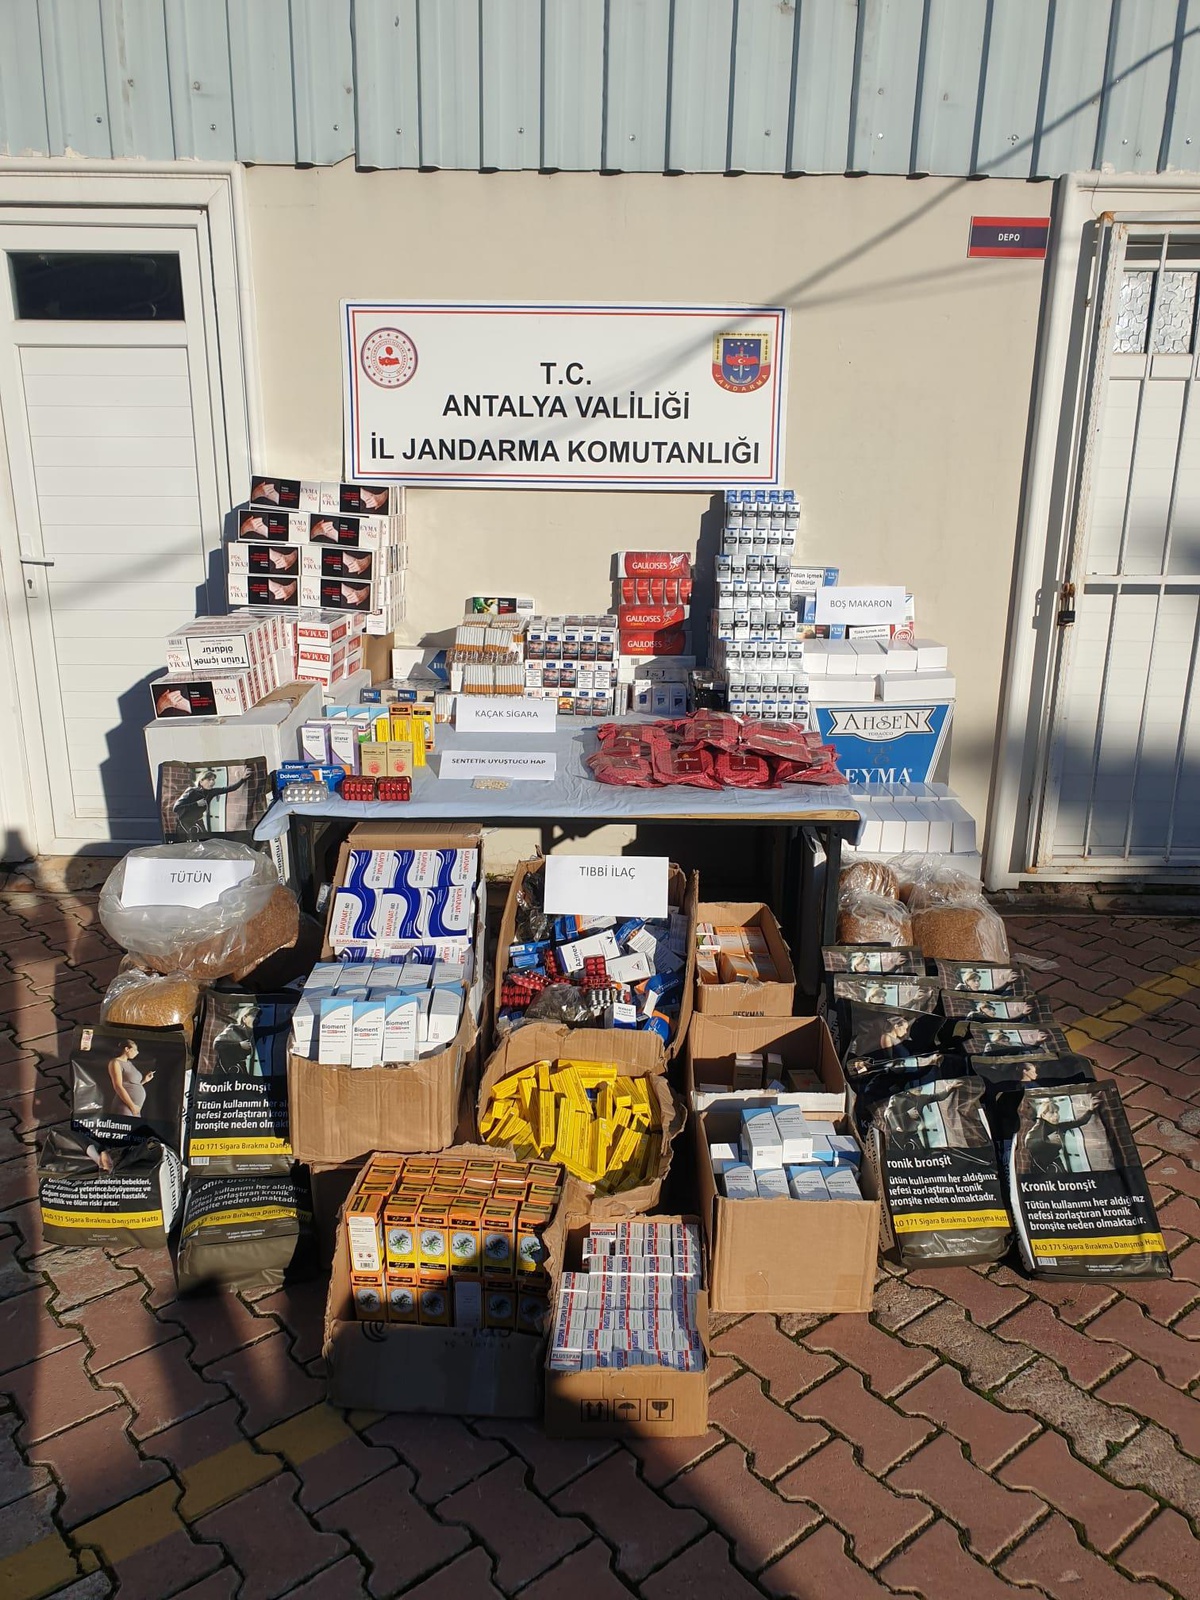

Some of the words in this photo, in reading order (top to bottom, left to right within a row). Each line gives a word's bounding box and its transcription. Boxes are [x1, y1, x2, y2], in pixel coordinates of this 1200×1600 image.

[997, 233, 1020, 242] DEPO
[540, 362, 592, 386] T.C.
[442, 394, 567, 418] ANTALYA
[575, 391, 690, 420] VALİLİĞİ
[371, 432, 394, 460] İL
[402, 437, 560, 463] JANDARMA
[568, 436, 760, 464] KOMUTANLIĞI
[830, 600, 847, 609] BOŞ
[849, 600, 892, 608] MAKARON
[202, 645, 233, 654] öldürür
[194, 657, 217, 666] içmek
[222, 656, 246, 665] Tütün
[475, 710, 504, 718] KAÇAK
[506, 709, 539, 718] SİGARA
[843, 712, 920, 730] AHSEN
[844, 768, 912, 784] EYMA
[170, 871, 212, 883] TÜTÜN
[580, 865, 608, 877] TIBBİ
[611, 865, 636, 879] İLAÇ
[199, 1081, 232, 1093] Kronik
[235, 1081, 271, 1093] bronşit
[197, 1101, 221, 1109] Tütün
[223, 1099, 261, 1108] kullanımı
[196, 1111, 221, 1119] nefesi
[223, 1110, 267, 1119] zorlaştıran
[97, 1119, 132, 1131] kullanımı
[195, 1121, 229, 1131] bronşite
[231, 1120, 257, 1128] neden
[192, 1143, 204, 1151] ALO
[219, 1143, 240, 1151] Sigara
[887, 1158, 913, 1169] ronik
[914, 1155, 952, 1167] bronşit
[889, 1176, 908, 1185] ütün
[909, 1174, 947, 1185] kullanımı
[948, 1174, 961, 1183] her
[962, 1172, 997, 1183] aldığınız
[913, 1184, 955, 1197] zorlaştıran
[955, 1183, 983, 1193] kronik
[1021, 1181, 1057, 1193] Kronik
[1058, 1179, 1097, 1193] bronşit
[222, 1197, 249, 1205] neden
[923, 1195, 950, 1204] neden
[950, 1192, 997, 1204] olmaktadır.
[1025, 1200, 1050, 1210] Tütün
[1051, 1198, 1092, 1210] kullanımı
[1093, 1197, 1108, 1207] her
[1027, 1210, 1054, 1220] nefesi
[1055, 1208, 1102, 1221] zorlaştıran
[1103, 1206, 1131, 1217] kronik
[112, 1217, 140, 1225] Danışma
[906, 1218, 917, 1226] 171
[919, 1217, 940, 1226] Sigara
[967, 1215, 994, 1224] Danışma
[1029, 1221, 1065, 1232] bronşite
[1067, 1220, 1095, 1230] neden
[1062, 1242, 1084, 1251] Sigara
[1114, 1241, 1143, 1251] Danışma
